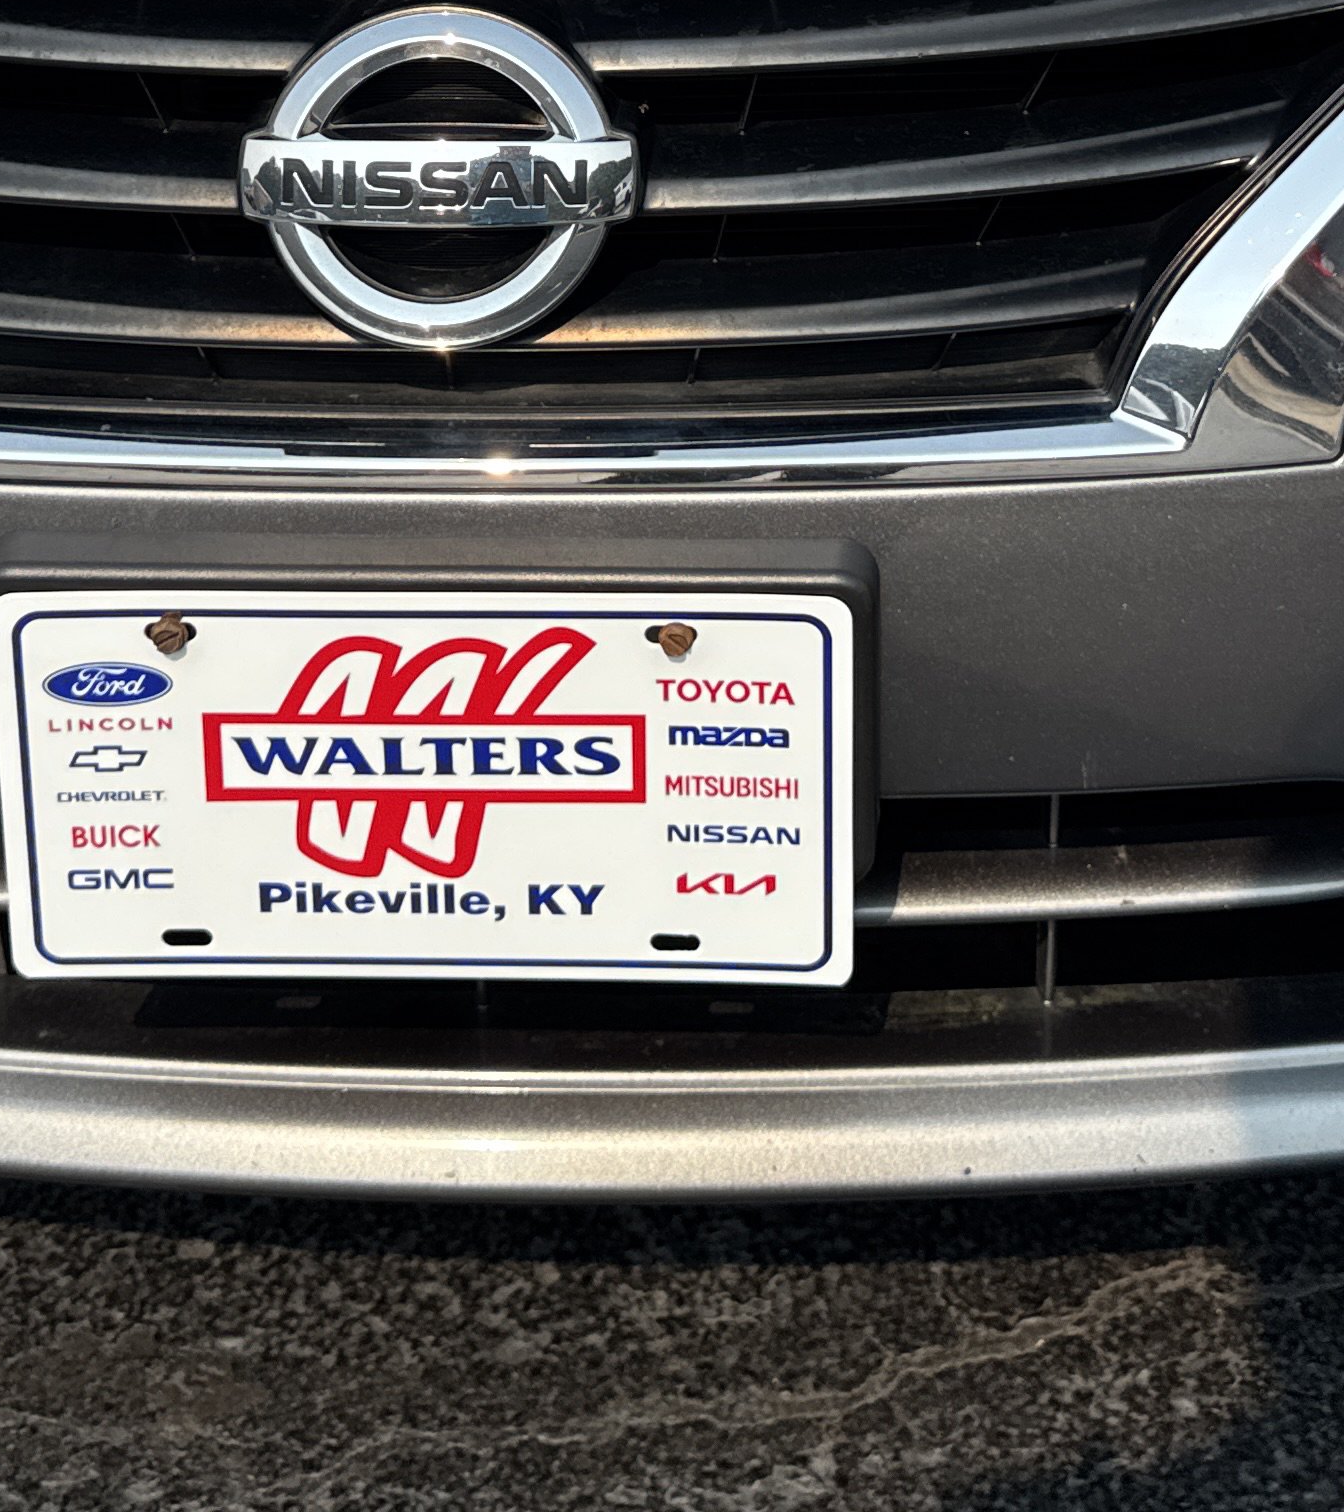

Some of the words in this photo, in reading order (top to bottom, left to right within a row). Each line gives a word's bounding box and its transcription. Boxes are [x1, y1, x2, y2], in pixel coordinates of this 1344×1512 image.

[280, 156, 589, 209] NISSAN
[71, 668, 146, 696] Ford
[655, 679, 796, 706] TOYOTA
[48, 717, 174, 733] LINCOLN
[231, 736, 622, 776] WALTERS
[56, 790, 166, 803] CHEVROLET
[665, 774, 799, 799] MITSUBISHI
[71, 824, 161, 848] BUICK
[667, 824, 801, 845] NISSAN
[67, 868, 174, 890] GMC
[676, 872, 776, 896] KIA
[258, 882, 506, 921] Pikeville,
[527, 884, 606, 915] KY
